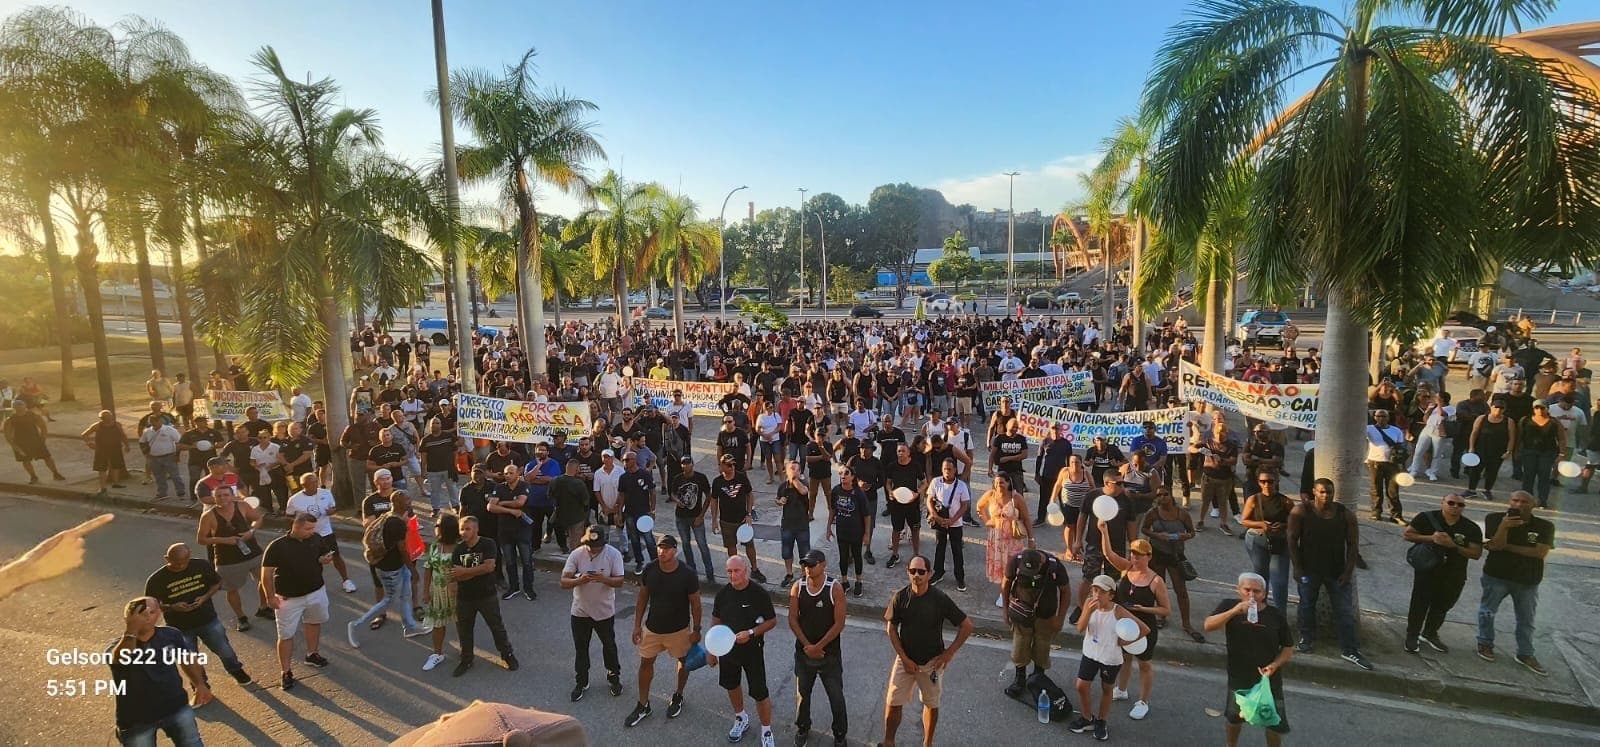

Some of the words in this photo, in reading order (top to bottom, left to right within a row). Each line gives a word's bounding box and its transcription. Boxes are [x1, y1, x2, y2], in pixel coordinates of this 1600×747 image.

[634, 378, 684, 390] PREFEITO
[686, 383, 732, 394] MENTIU
[460, 394, 505, 411] PREFEITO
[459, 407, 481, 419] QUER
[484, 409, 508, 423] CRIAR
[510, 411, 585, 427] PARALELA
[1055, 408, 1115, 425] MUNICIPAL
[469, 420, 520, 435] CONTRATADOS
[1073, 422, 1184, 436] APROXIMADAENTE
